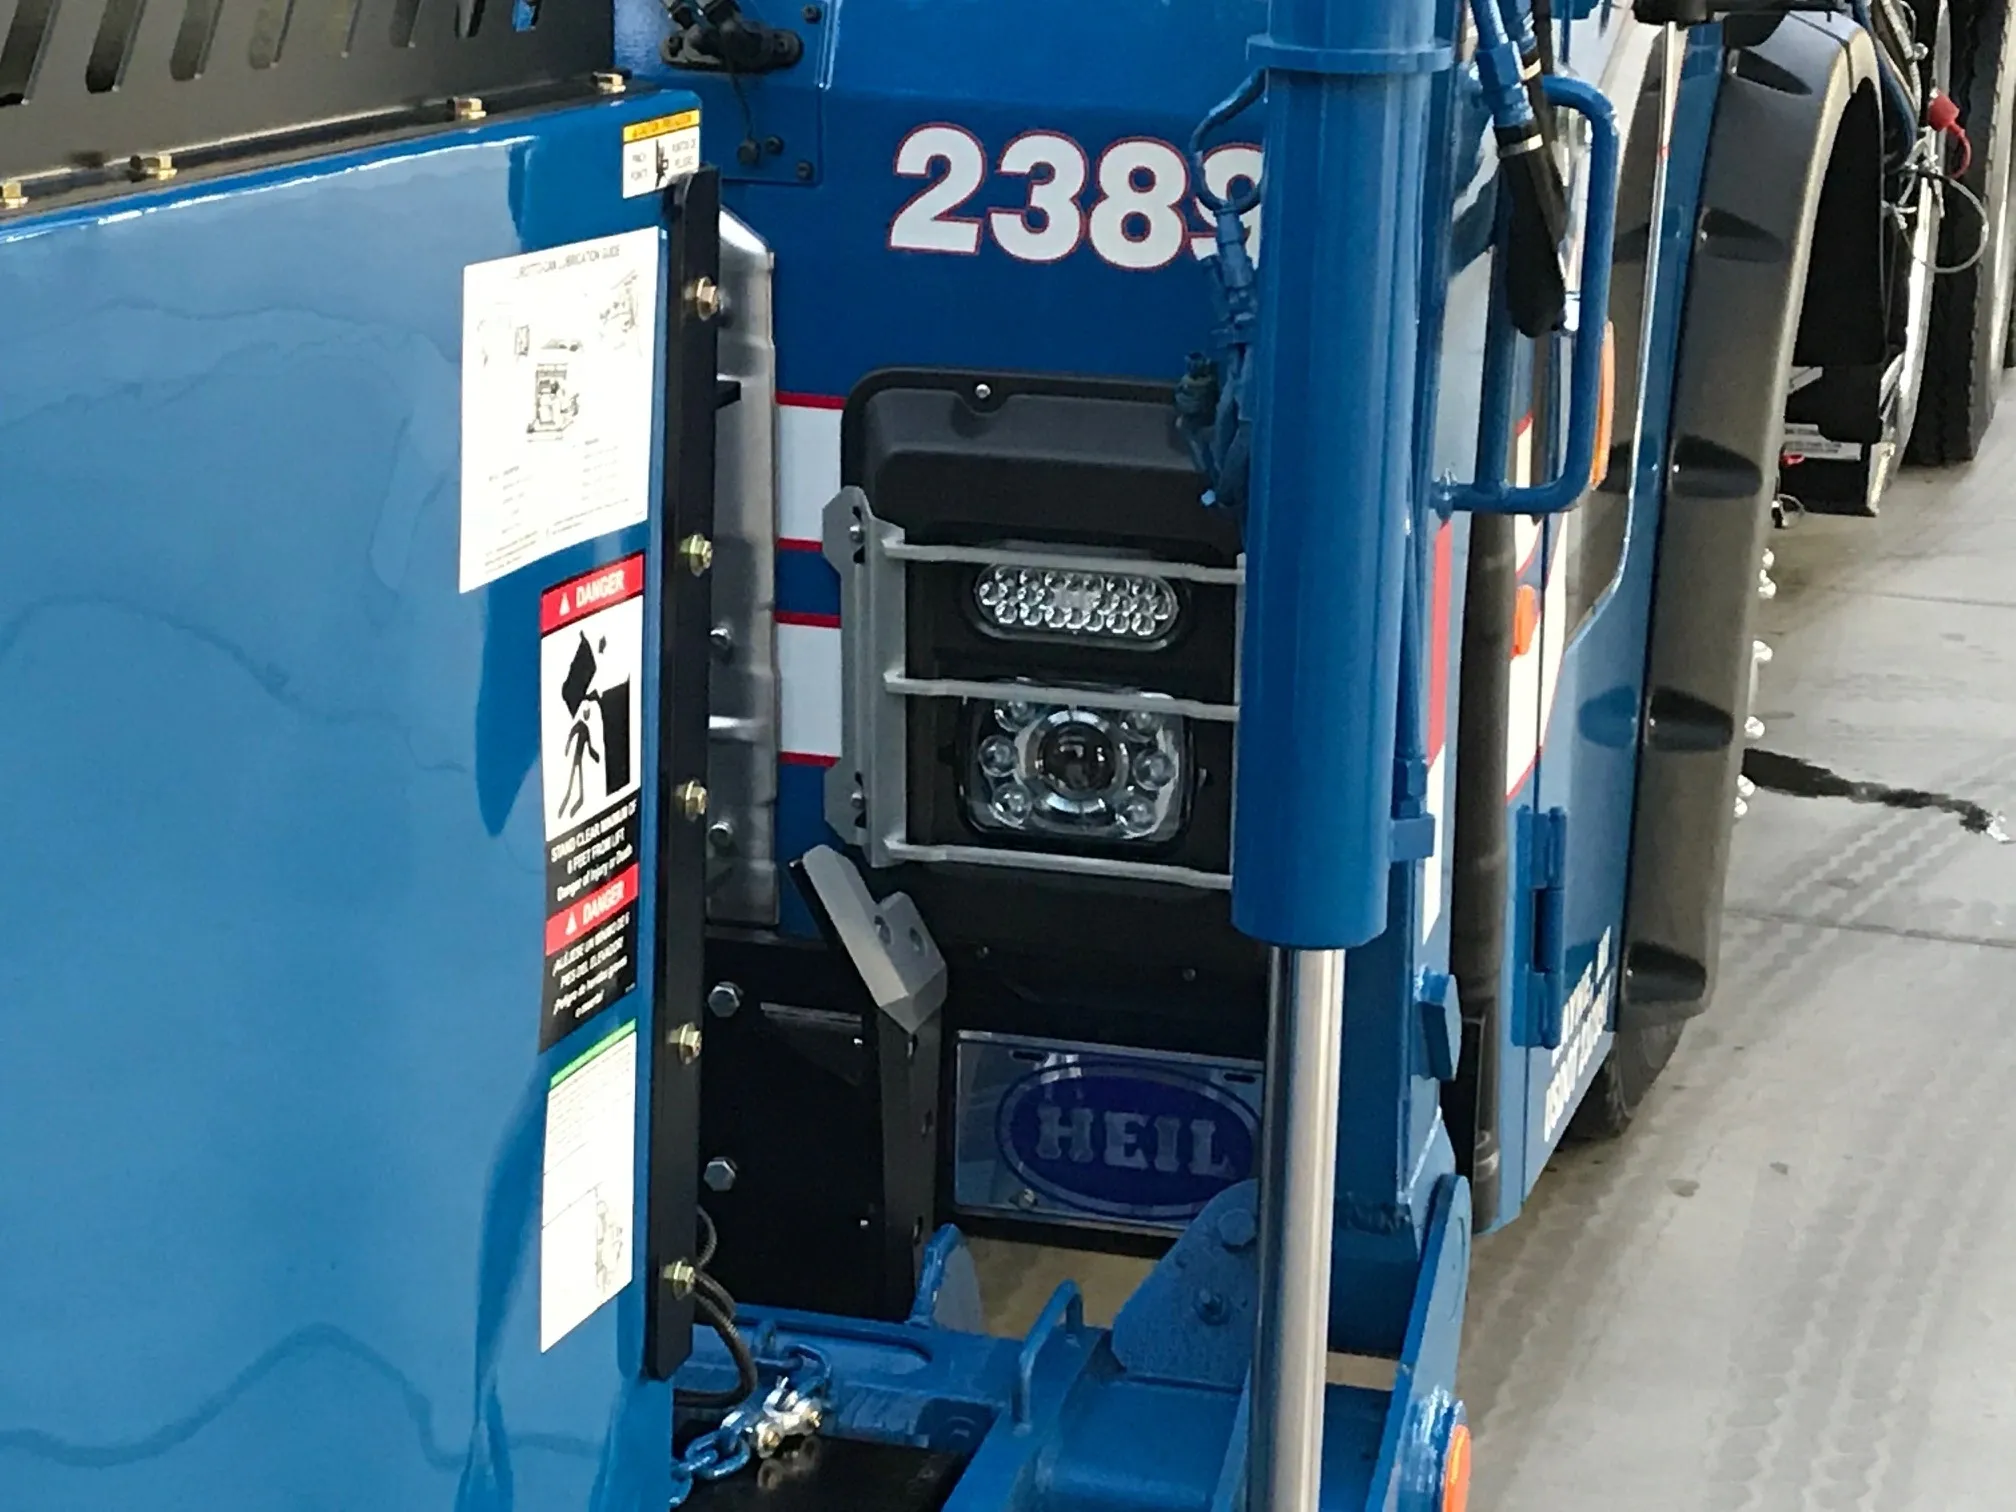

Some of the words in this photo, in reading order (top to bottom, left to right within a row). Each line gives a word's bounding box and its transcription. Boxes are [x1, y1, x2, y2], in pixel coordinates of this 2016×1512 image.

[887, 121, 1264, 271] 2389
[575, 568, 625, 609] DANGER
[551, 836, 576, 863] STAND
[576, 822, 601, 848] CLEAR
[582, 880, 625, 926] DANGER
[1035, 1104, 1237, 1181] HEIL
